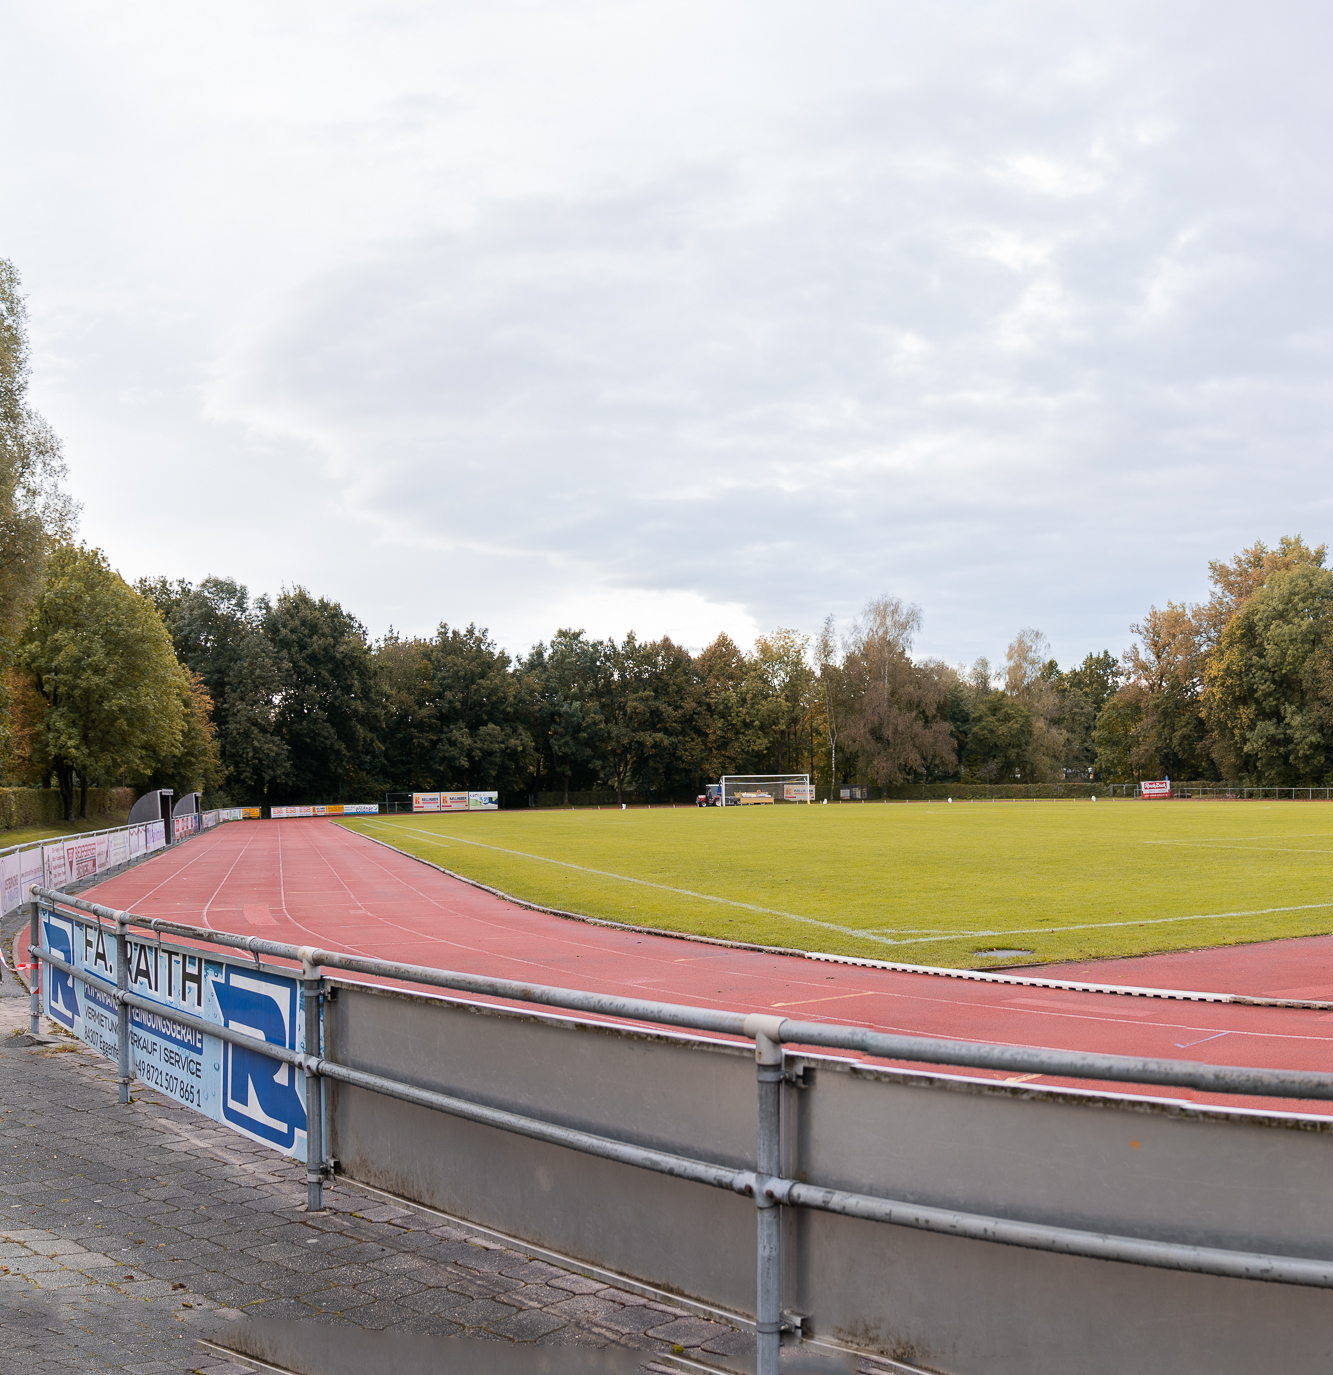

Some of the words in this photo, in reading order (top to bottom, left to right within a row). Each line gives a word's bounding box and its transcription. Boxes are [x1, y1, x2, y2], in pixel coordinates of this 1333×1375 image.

[84, 924, 113, 974] FA.
[127, 941, 202, 1008] RAITH
[85, 1004, 118, 1035] VERMIETUN
[164, 1049, 201, 1079] SERVICE
[146, 1063, 163, 1087] 8721
[165, 1074, 178, 1094] 507
[180, 1081, 194, 1103] 865
